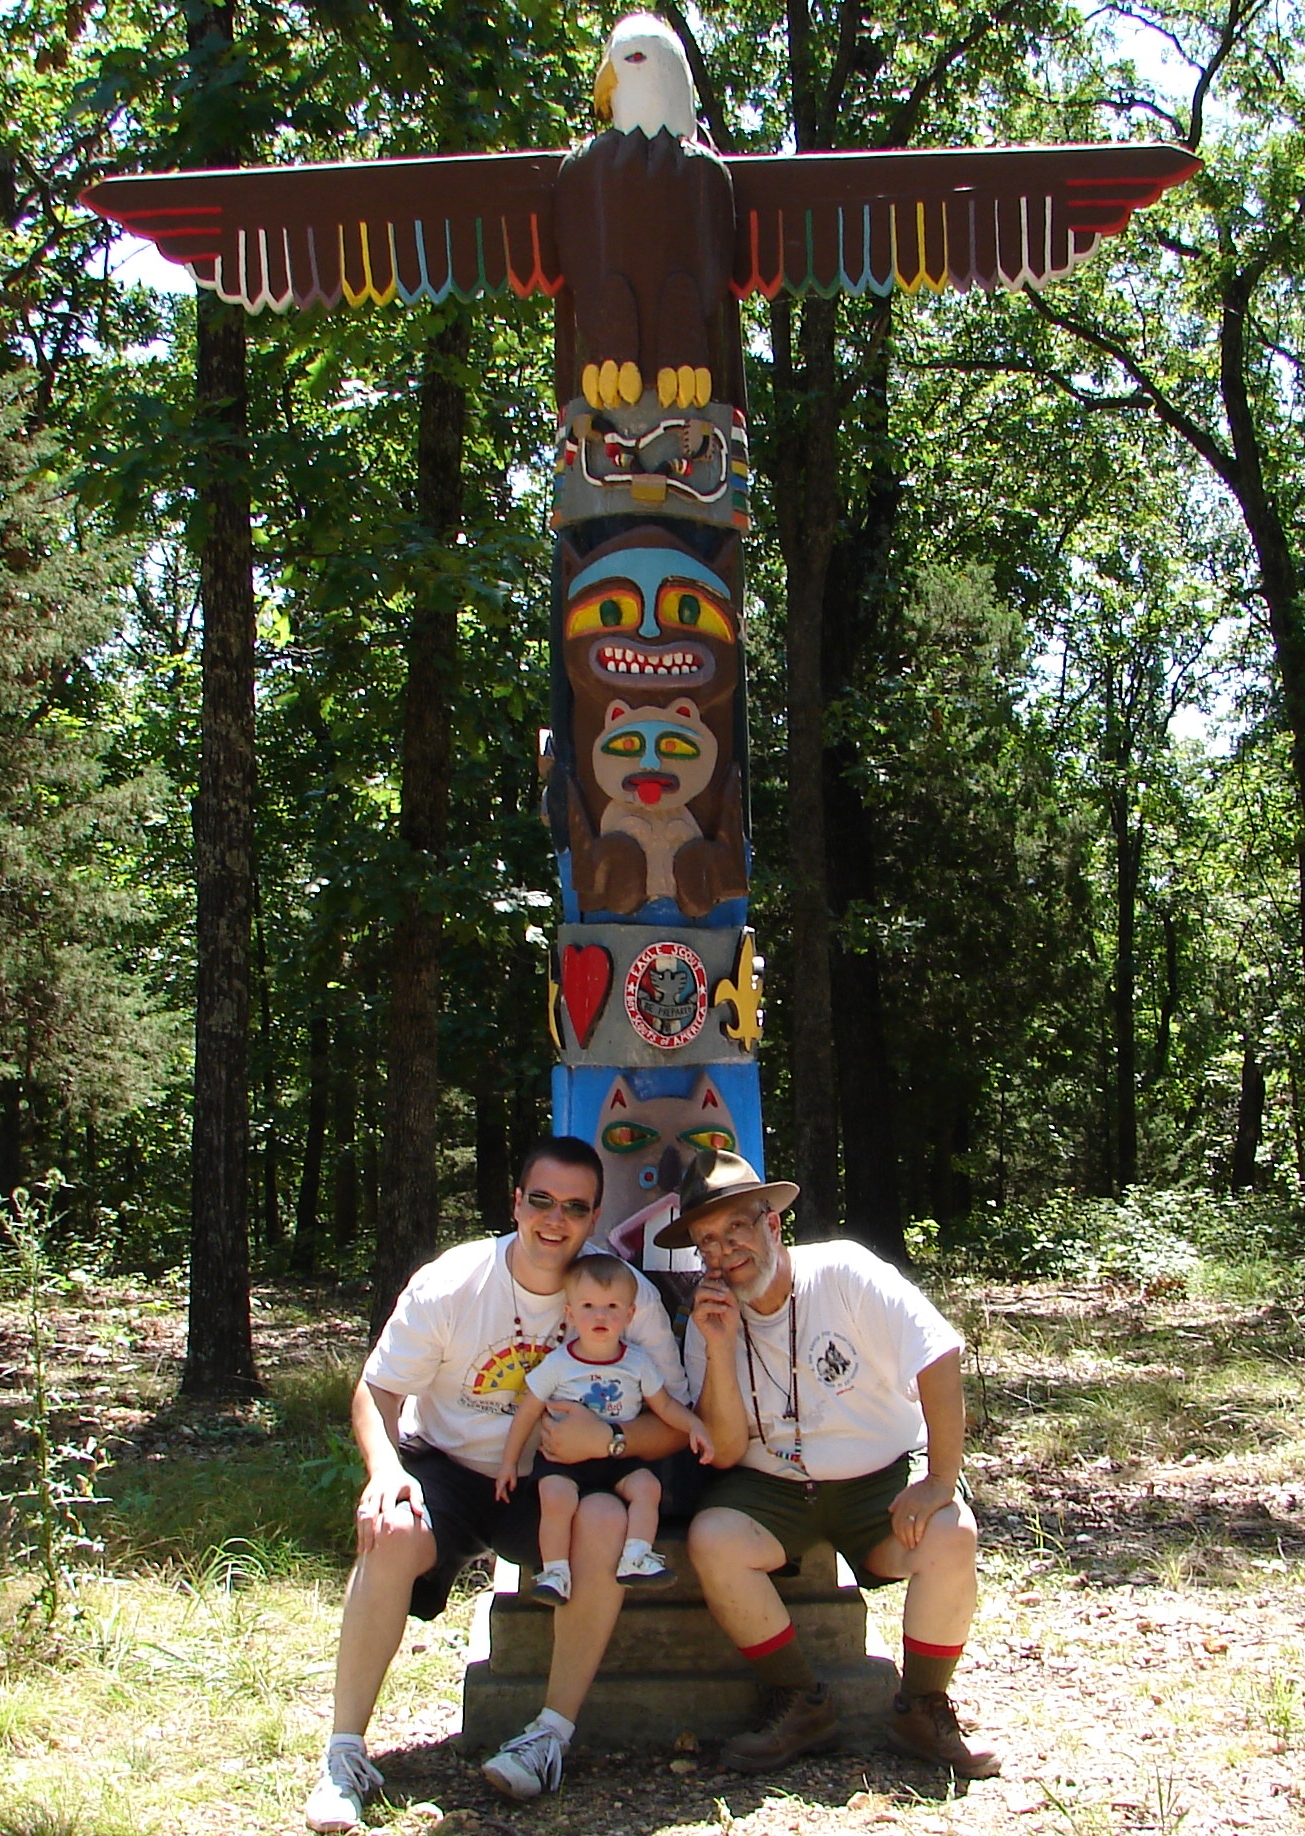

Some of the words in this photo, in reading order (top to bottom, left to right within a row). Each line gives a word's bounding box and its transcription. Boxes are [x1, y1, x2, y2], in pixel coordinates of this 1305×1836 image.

[631, 945, 663, 977] EAGLE
[671, 945, 704, 971] SCOUT
[631, 1014, 658, 1042] SCOUTS
[673, 1007, 706, 1047] AMERICA
